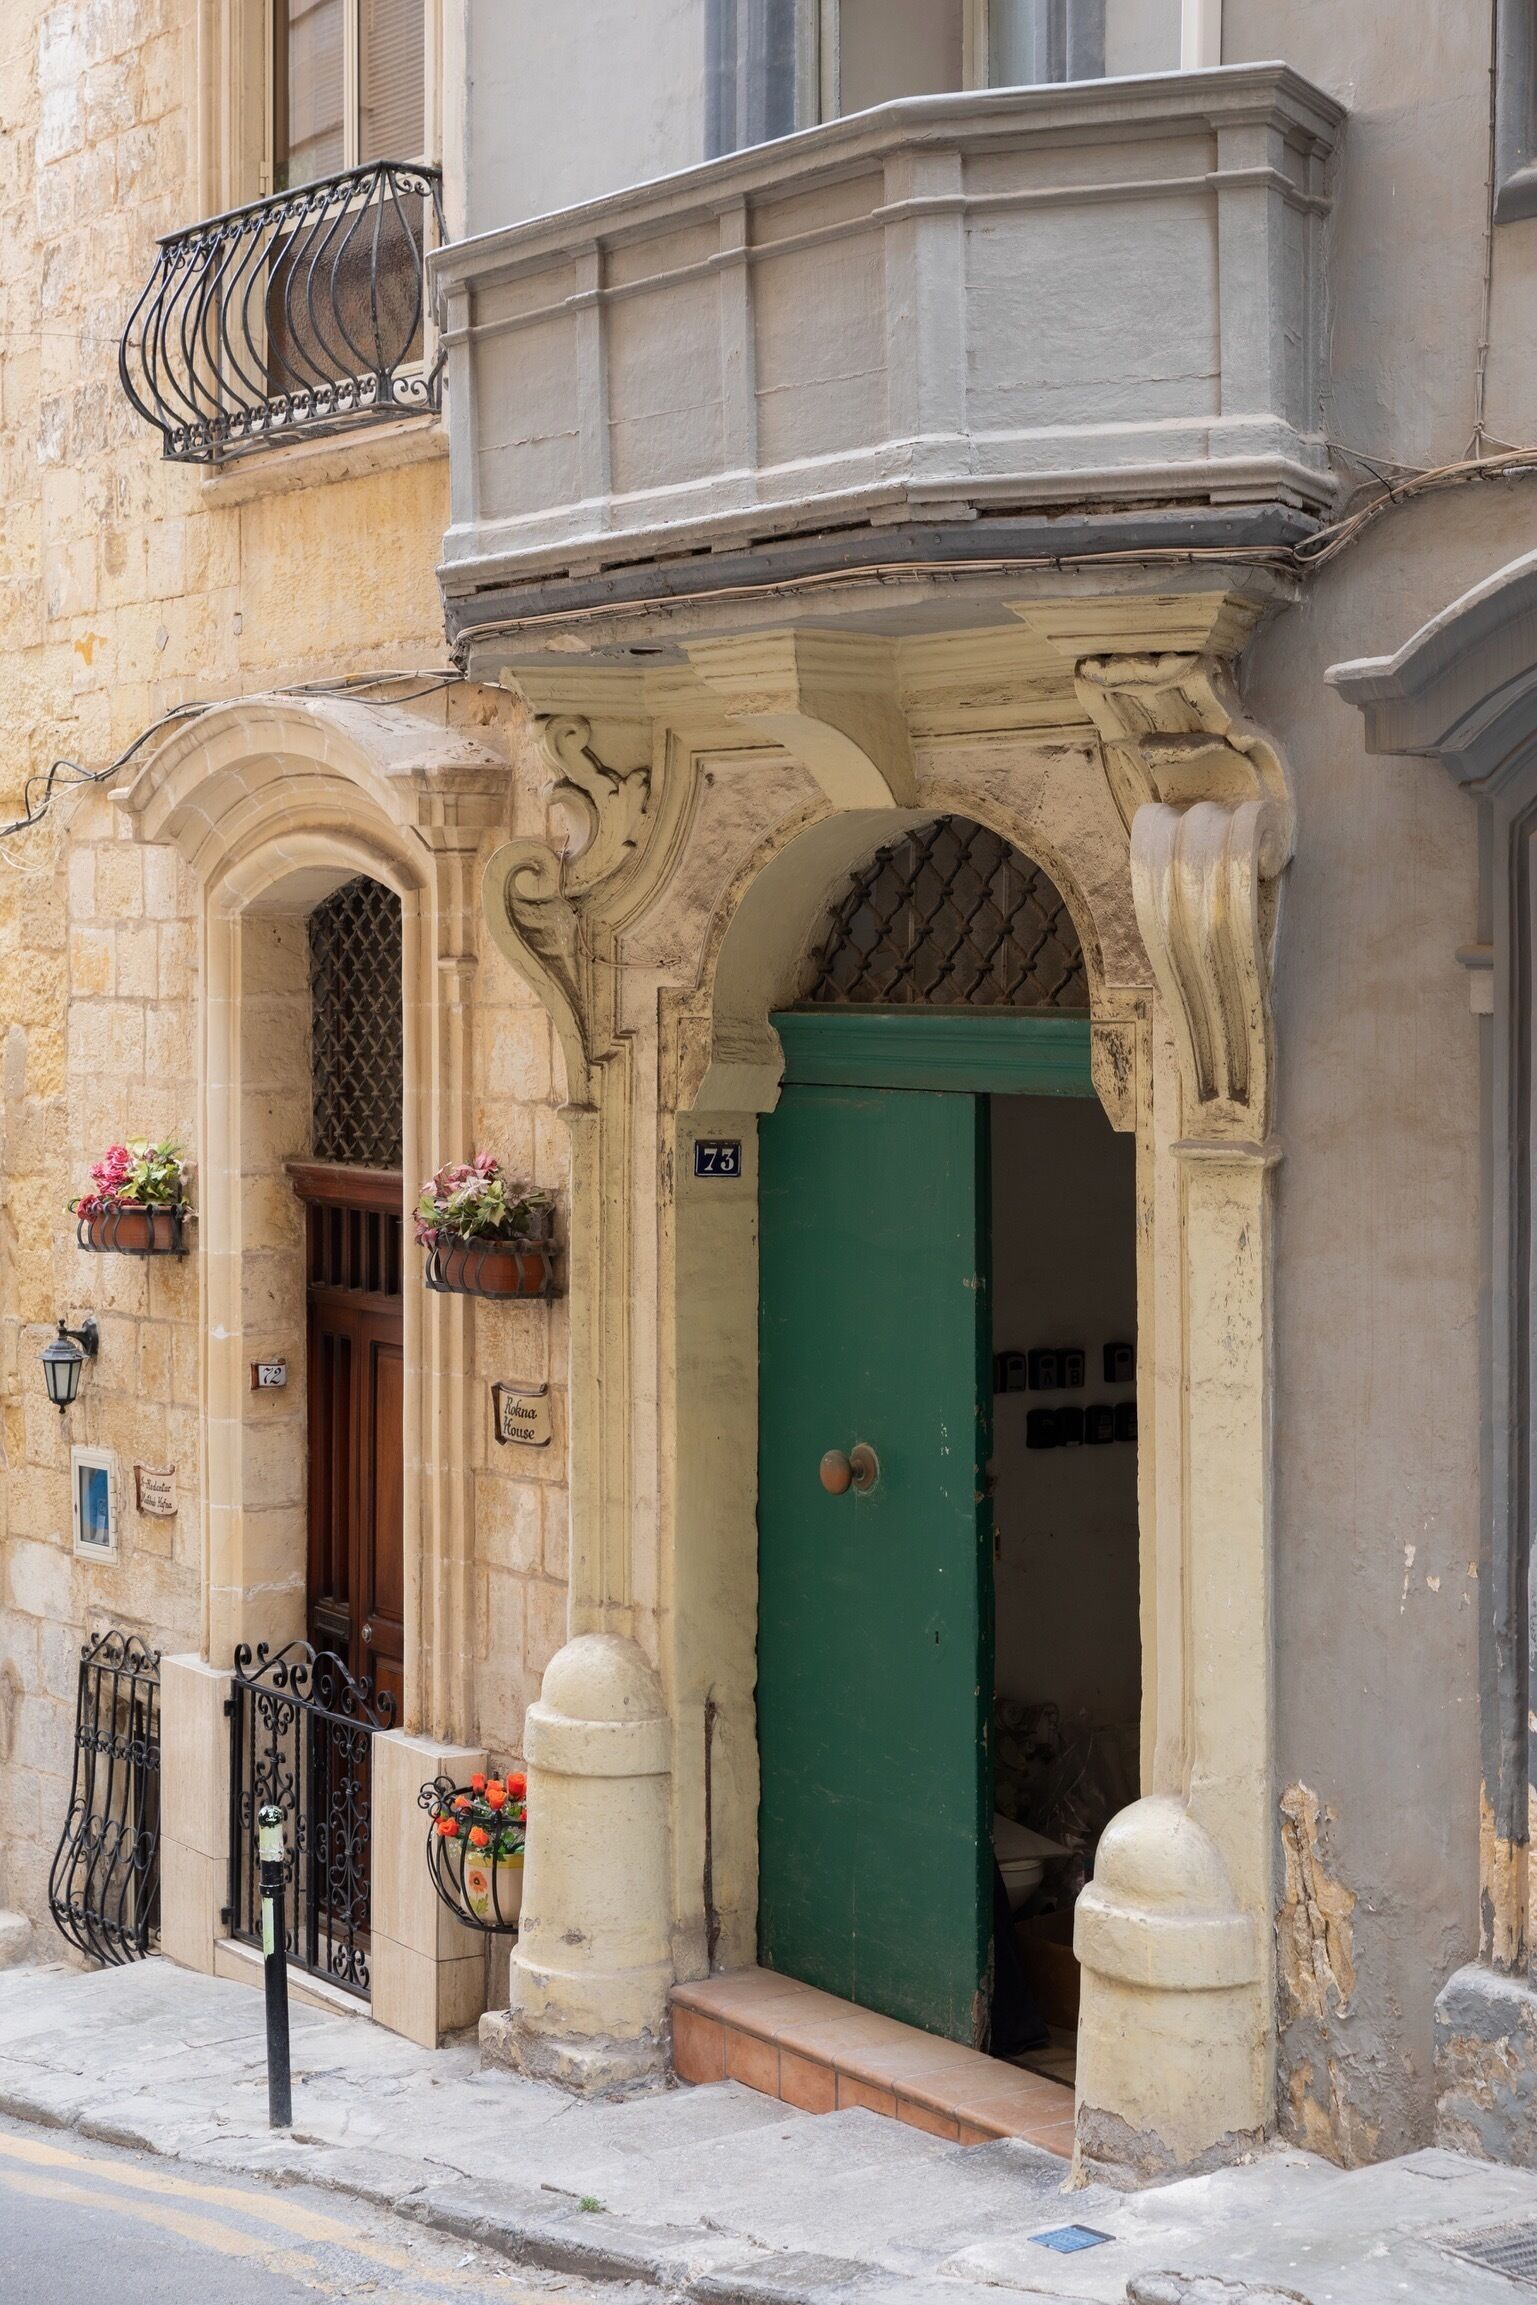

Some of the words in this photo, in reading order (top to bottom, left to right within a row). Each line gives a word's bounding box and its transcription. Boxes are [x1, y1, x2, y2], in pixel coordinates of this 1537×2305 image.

[704, 1148, 735, 1171] 73
[263, 1367, 282, 1385] 72
[504, 1395, 538, 1419] Rokna
[503, 1415, 535, 1440] House
